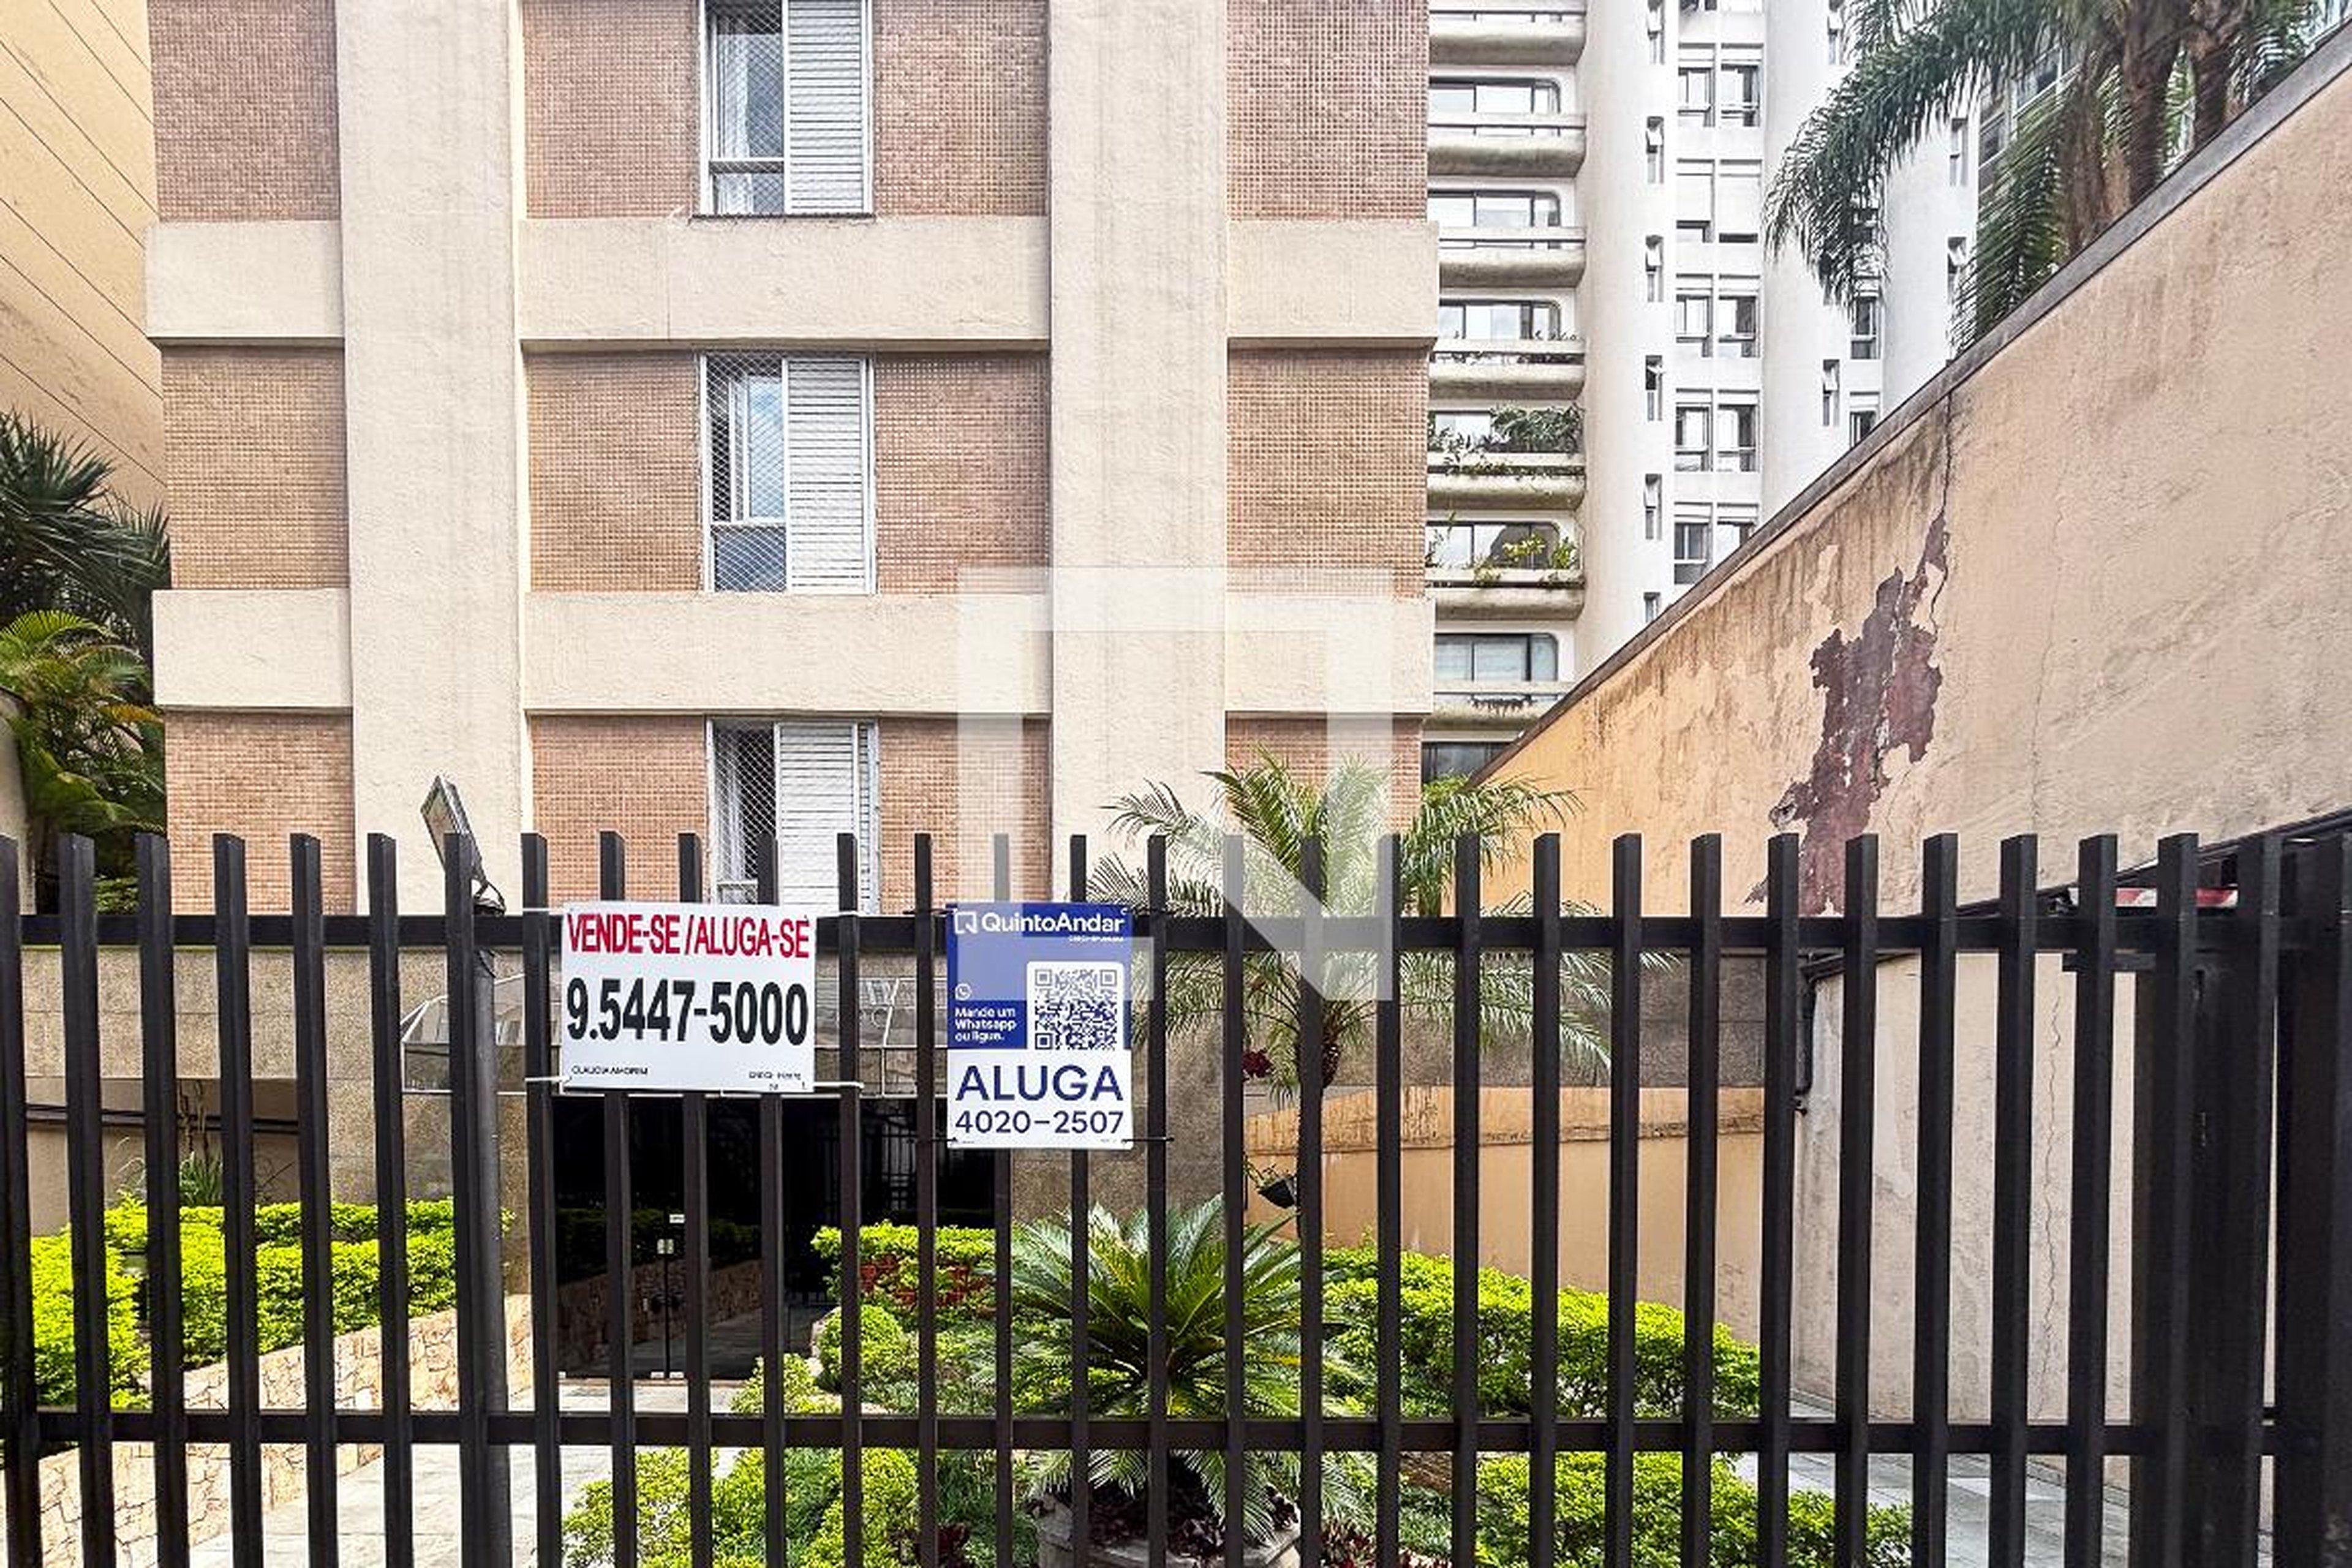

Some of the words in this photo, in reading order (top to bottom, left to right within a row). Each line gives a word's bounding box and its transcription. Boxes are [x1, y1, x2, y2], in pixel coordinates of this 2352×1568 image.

[567, 913, 680, 954] VENDE-SE
[982, 912, 1124, 933] QuintoAndar
[567, 978, 807, 1046] 9.5447-5000
[997, 1008, 1016, 1017] um
[955, 1065, 1123, 1101] ALUGA
